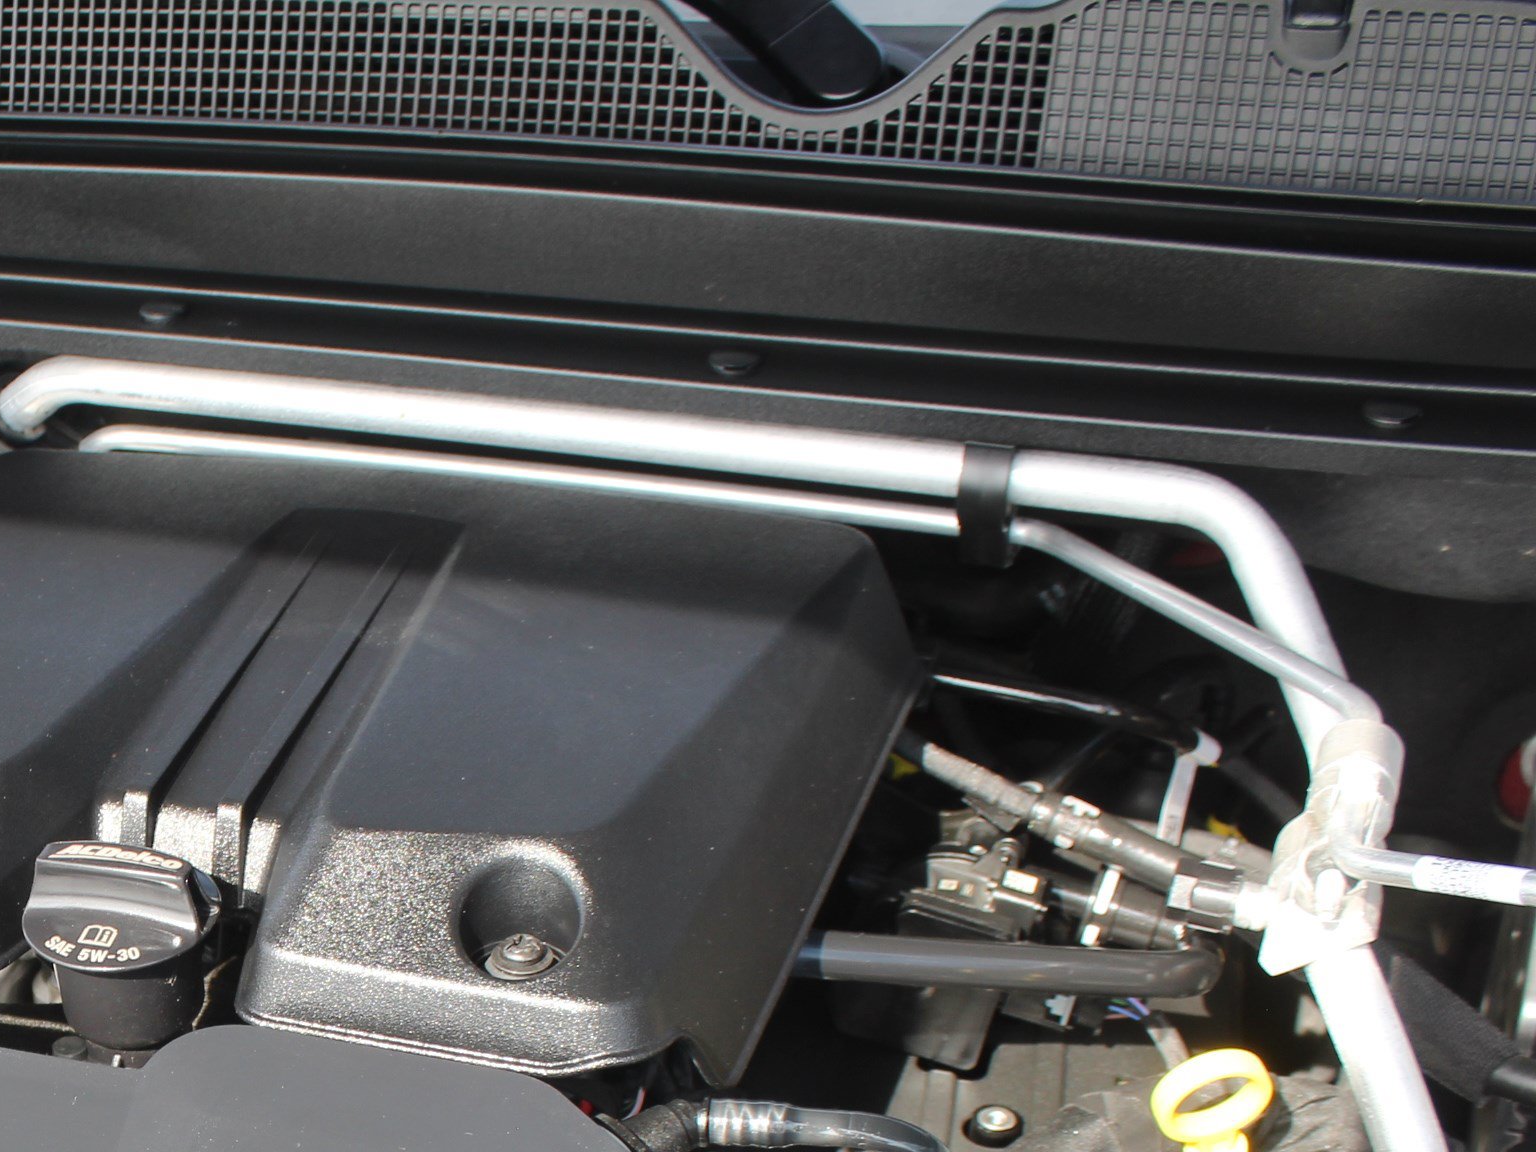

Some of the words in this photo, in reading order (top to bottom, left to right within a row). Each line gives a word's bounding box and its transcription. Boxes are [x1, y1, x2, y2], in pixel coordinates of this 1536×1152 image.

[49, 844, 183, 870] ACDelco
[45, 936, 76, 957] SAE
[77, 946, 140, 963] 5W-30
